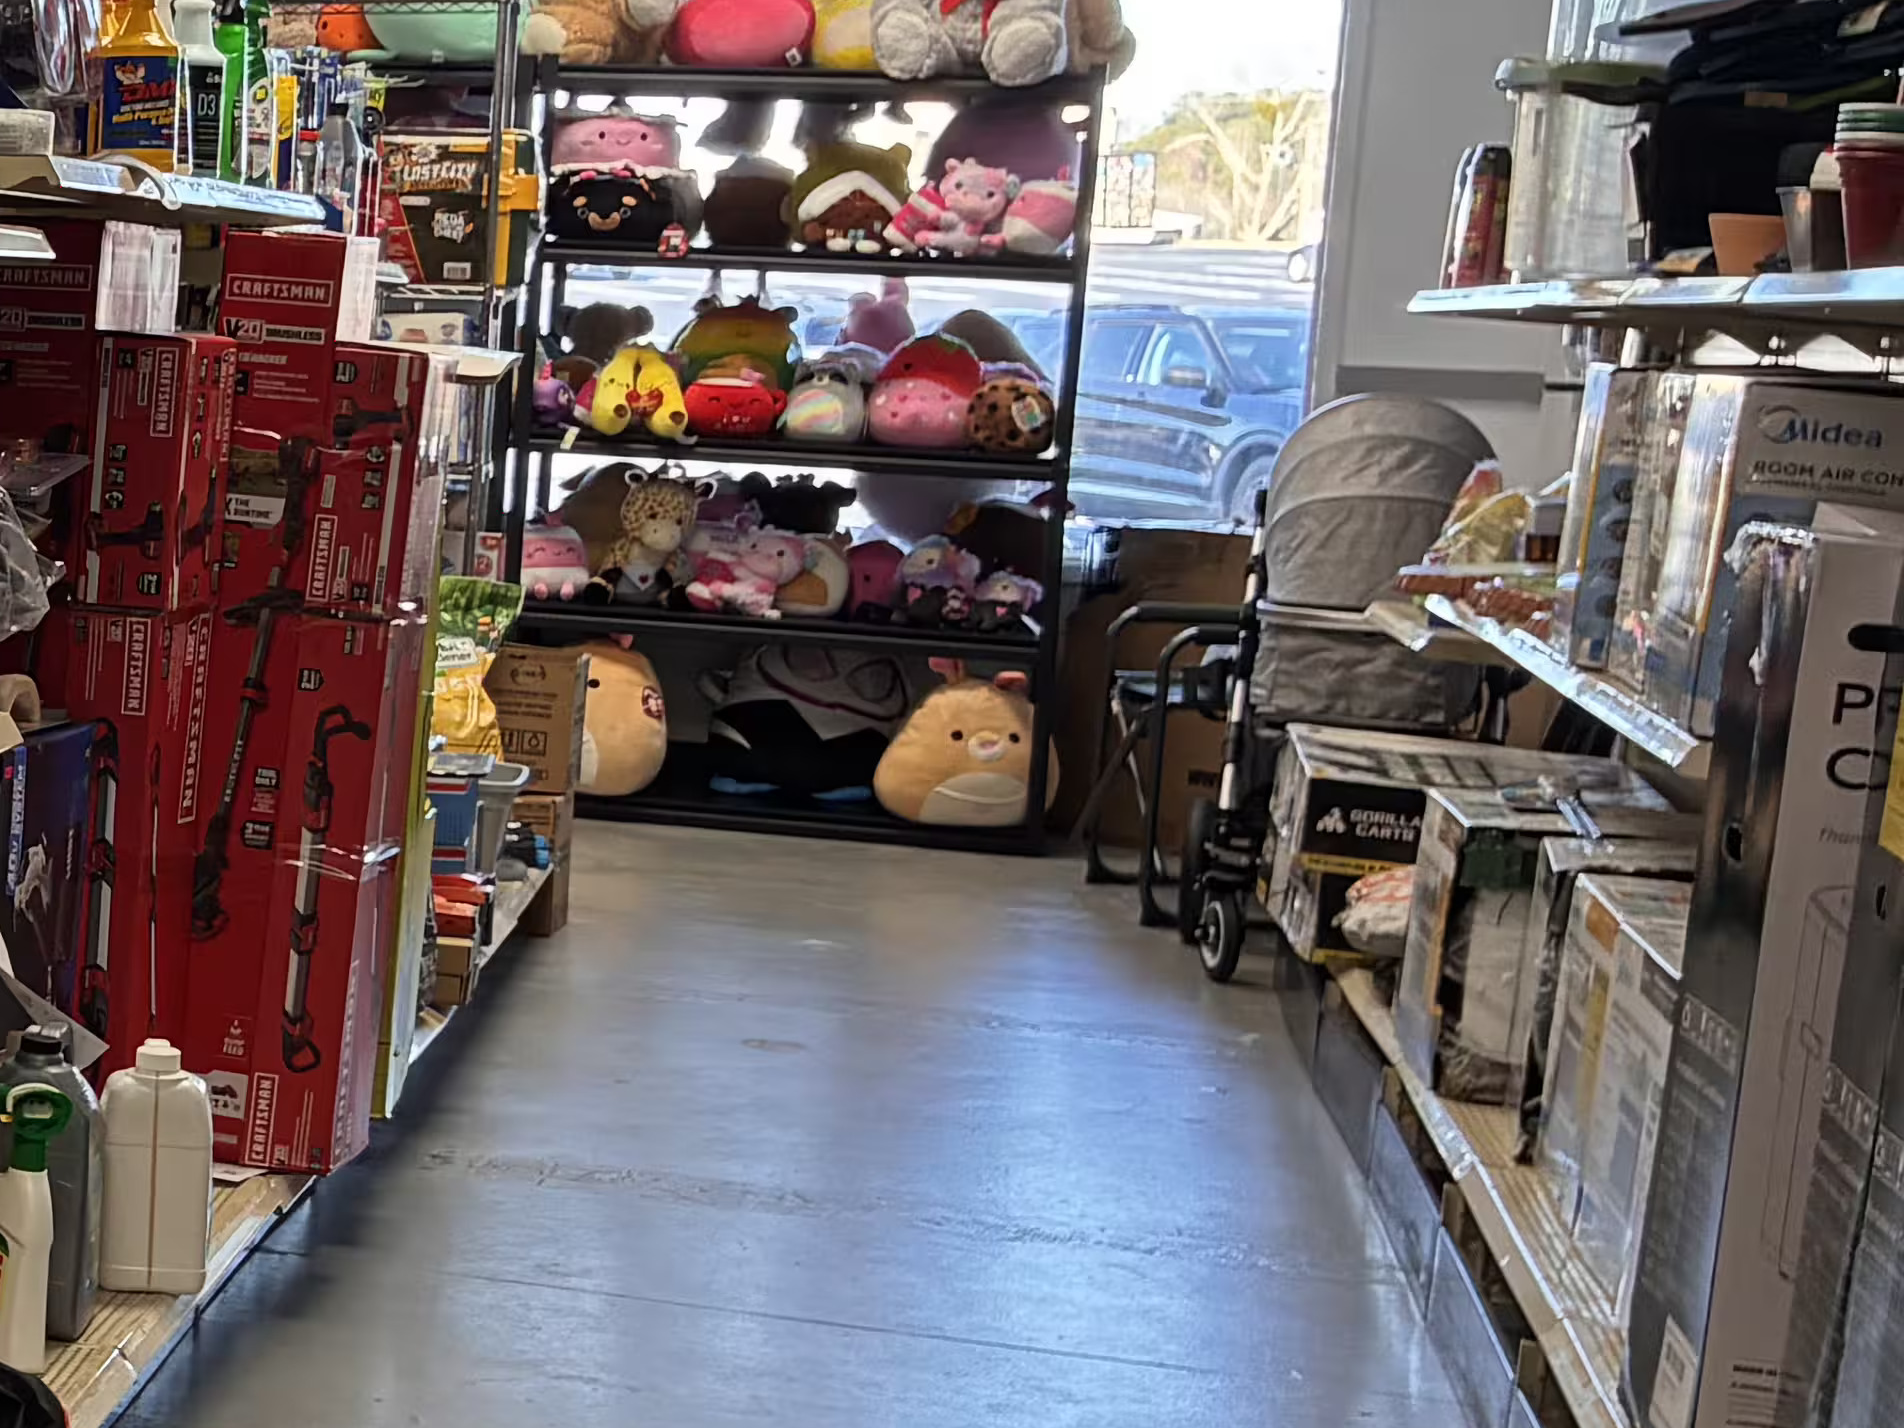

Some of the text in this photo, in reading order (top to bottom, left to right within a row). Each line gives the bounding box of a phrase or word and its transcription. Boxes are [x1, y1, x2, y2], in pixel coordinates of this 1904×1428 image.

[197, 92, 217, 117] D3
[231, 281, 328, 301] CRAFTSMAN
[153, 352, 175, 433] CRAFTSMAN
[1782, 415, 1885, 452] Midea
[1752, 458, 1816, 480] ROOM
[1822, 463, 1856, 483] AIR
[1858, 465, 1904, 489] CON
[311, 520, 333, 600] CRAFTSMAN
[127, 622, 146, 712] CRAFTSMAN
[182, 624, 209, 809] CRAFTSMAN
[1349, 808, 1423, 828] GORILLA
[1354, 823, 1416, 843] CARTS
[251, 1079, 273, 1161] CRAFTSMAN
